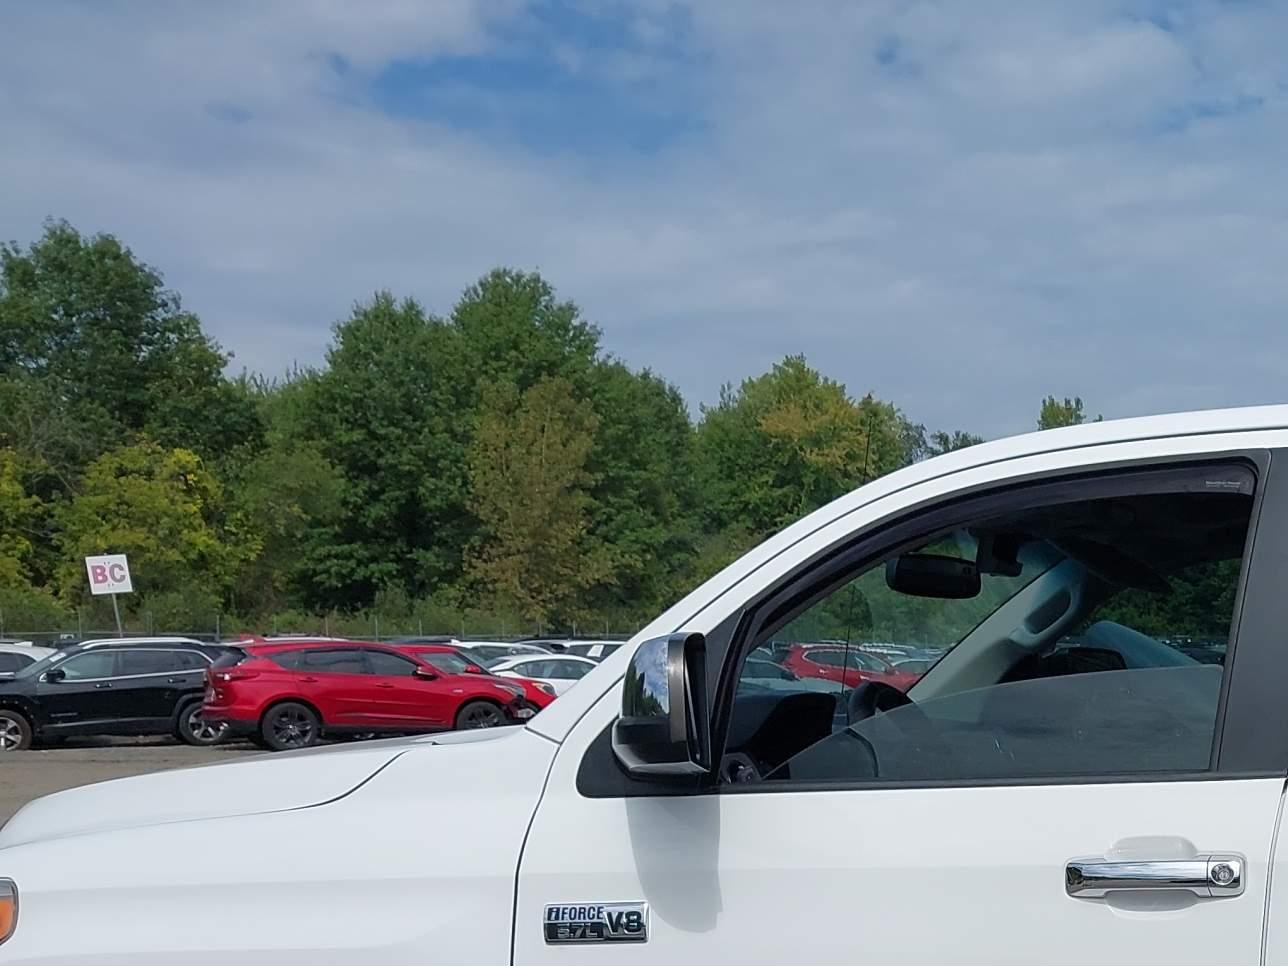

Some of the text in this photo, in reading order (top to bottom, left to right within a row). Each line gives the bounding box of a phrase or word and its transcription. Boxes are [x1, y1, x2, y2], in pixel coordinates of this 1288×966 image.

[91, 563, 126, 584] BC
[557, 923, 598, 939] 5.7L
[604, 911, 642, 935] V8
